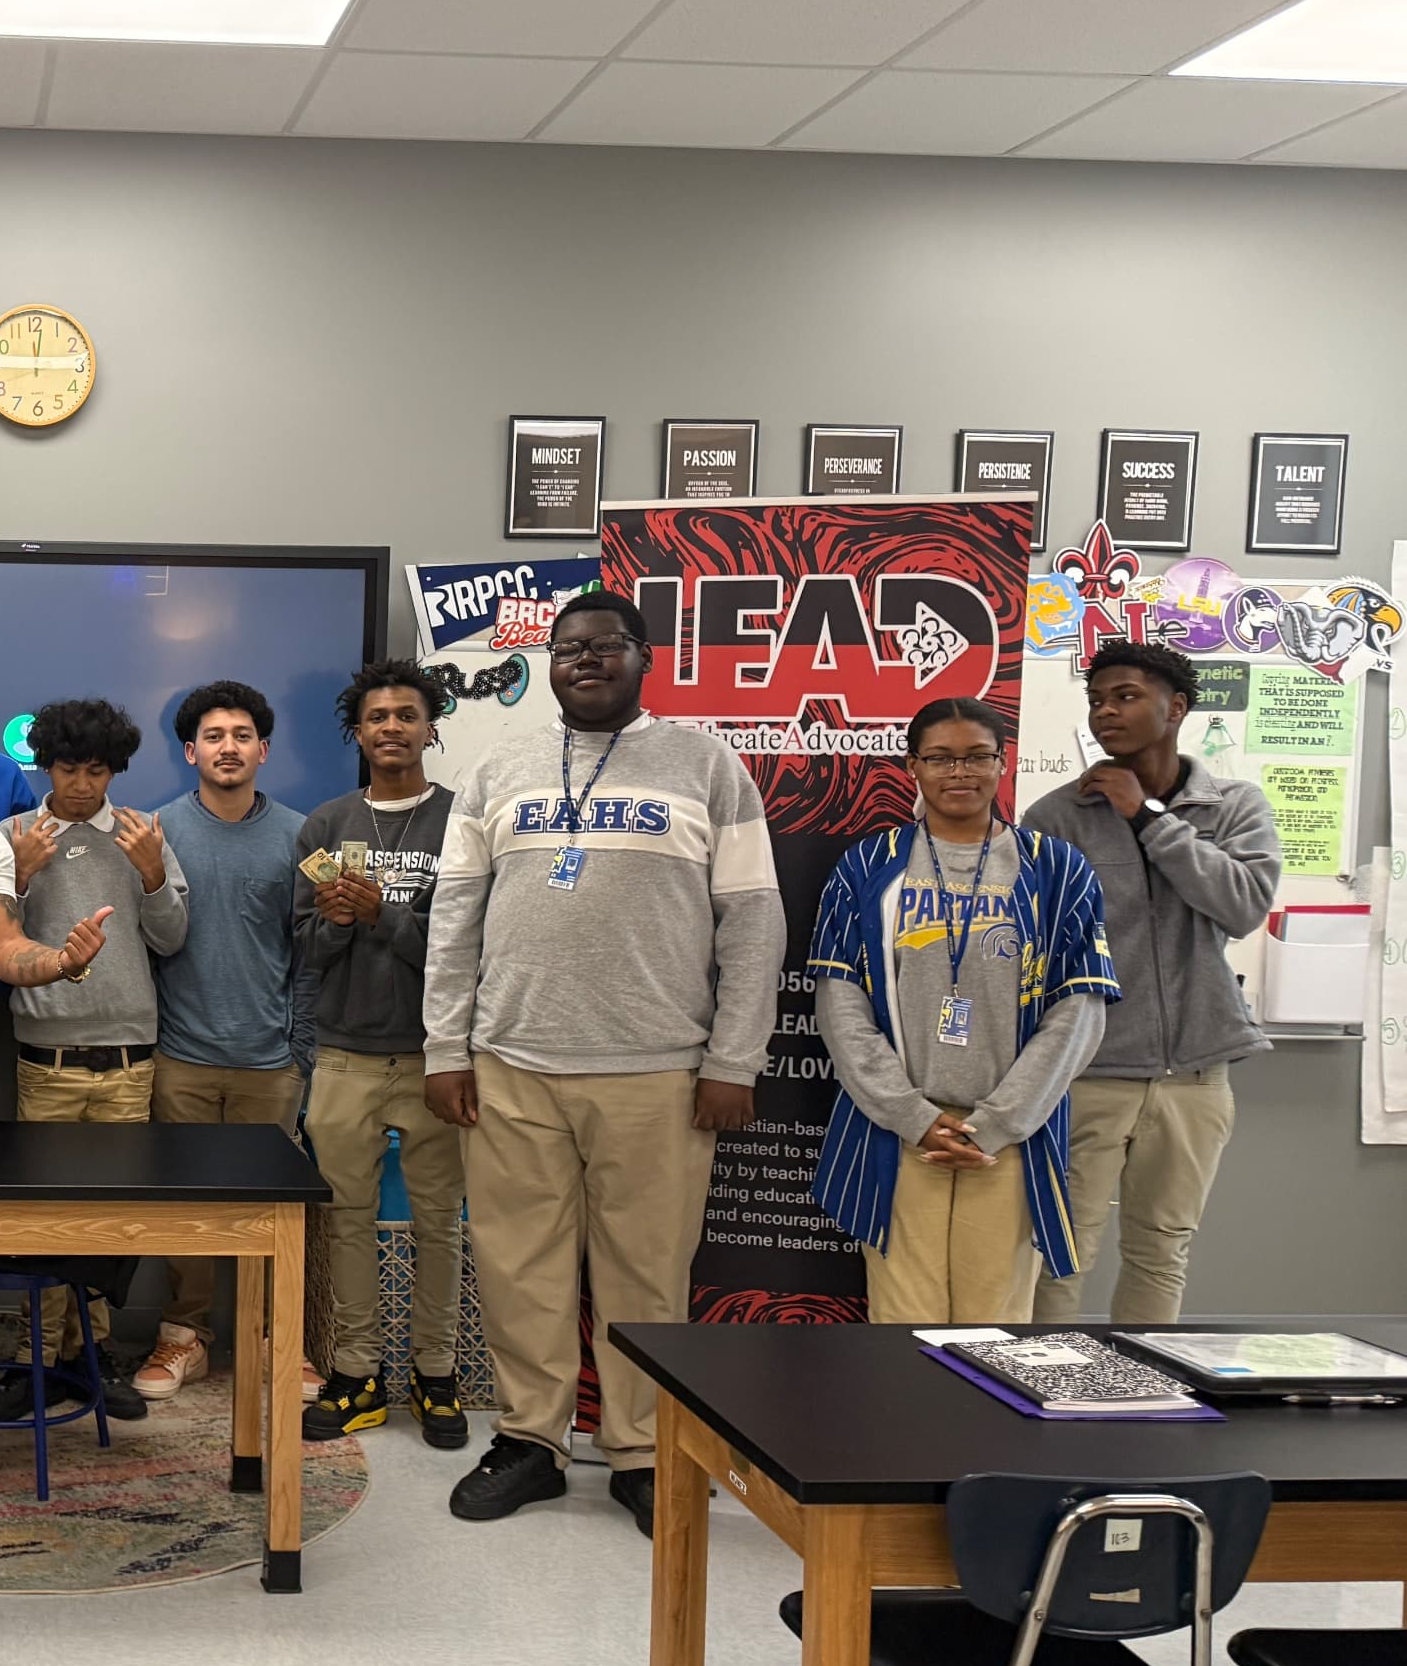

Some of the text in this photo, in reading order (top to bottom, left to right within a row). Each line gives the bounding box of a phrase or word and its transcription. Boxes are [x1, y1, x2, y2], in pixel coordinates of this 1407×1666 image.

[28, 317, 42, 333] 12
[67, 337, 78, 353] 2
[75, 356, 85, 373] 3
[67, 379, 79, 393] 4
[12, 396, 22, 411] 7
[32, 400, 44, 417] 6
[53, 394, 64, 410] 5
[532, 448, 582, 465] MINDSET
[683, 450, 736, 467] PASSION
[824, 457, 883, 475] PERSEVERANCE
[978, 462, 1032, 480] PERSISTENCE
[1122, 462, 1176, 479] SUCCESS
[1275, 465, 1326, 483] TALENT
[497, 597, 557, 627] BRC
[1177, 593, 1222, 616] LSU
[493, 621, 551, 649] Bea
[634, 574, 1000, 721] LEAD
[1293, 676, 1338, 686] MATER
[1259, 688, 1284, 696] THAT
[1295, 689, 1345, 698] SUPPOSED
[1274, 698, 1286, 706] TO
[1259, 707, 1341, 718] INDEPENDENTLY
[1297, 721, 1319, 729] AND
[1320, 721, 1344, 730] WILL
[1261, 736, 1297, 745] RESULT
[1039, 750, 1072, 774] buds
[513, 798, 671, 835] EAHS
[897, 887, 1015, 933] PARTAN
[717, 1141, 779, 1157] created
[784, 1144, 800, 1158] to
[737, 1162, 758, 1181] by
[762, 1165, 815, 1182] teachi
[754, 1187, 815, 1205] educati
[706, 1207, 737, 1222] and
[707, 1228, 861, 1254] become leaders of
